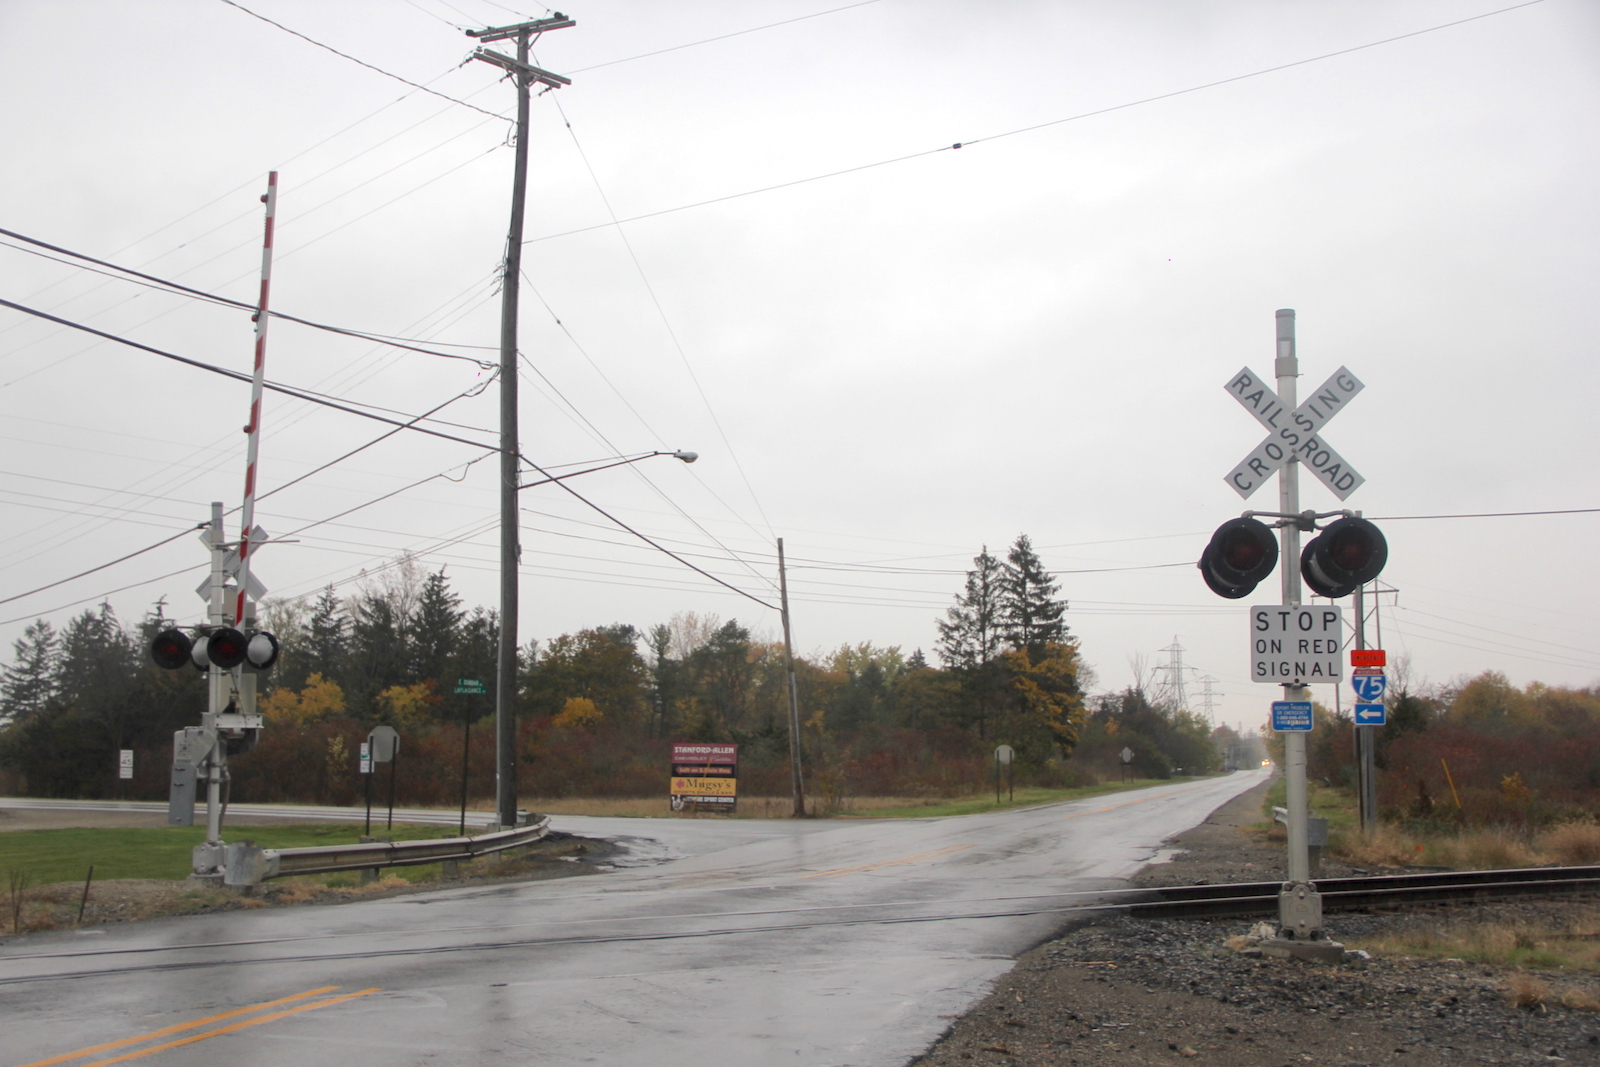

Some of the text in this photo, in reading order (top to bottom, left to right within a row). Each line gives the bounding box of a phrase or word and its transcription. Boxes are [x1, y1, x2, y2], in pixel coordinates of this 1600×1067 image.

[1233, 374, 1355, 491] CROSSING
[1256, 611, 1337, 632] STOP
[1256, 639, 1338, 654] ON RED
[1256, 661, 1338, 677] SIGNAL
[1354, 676, 1384, 695] 75
[674, 746, 734, 754] STANFORD-ALLEN
[121, 758, 132, 766] 45
[686, 778, 731, 792] Mugsy's
